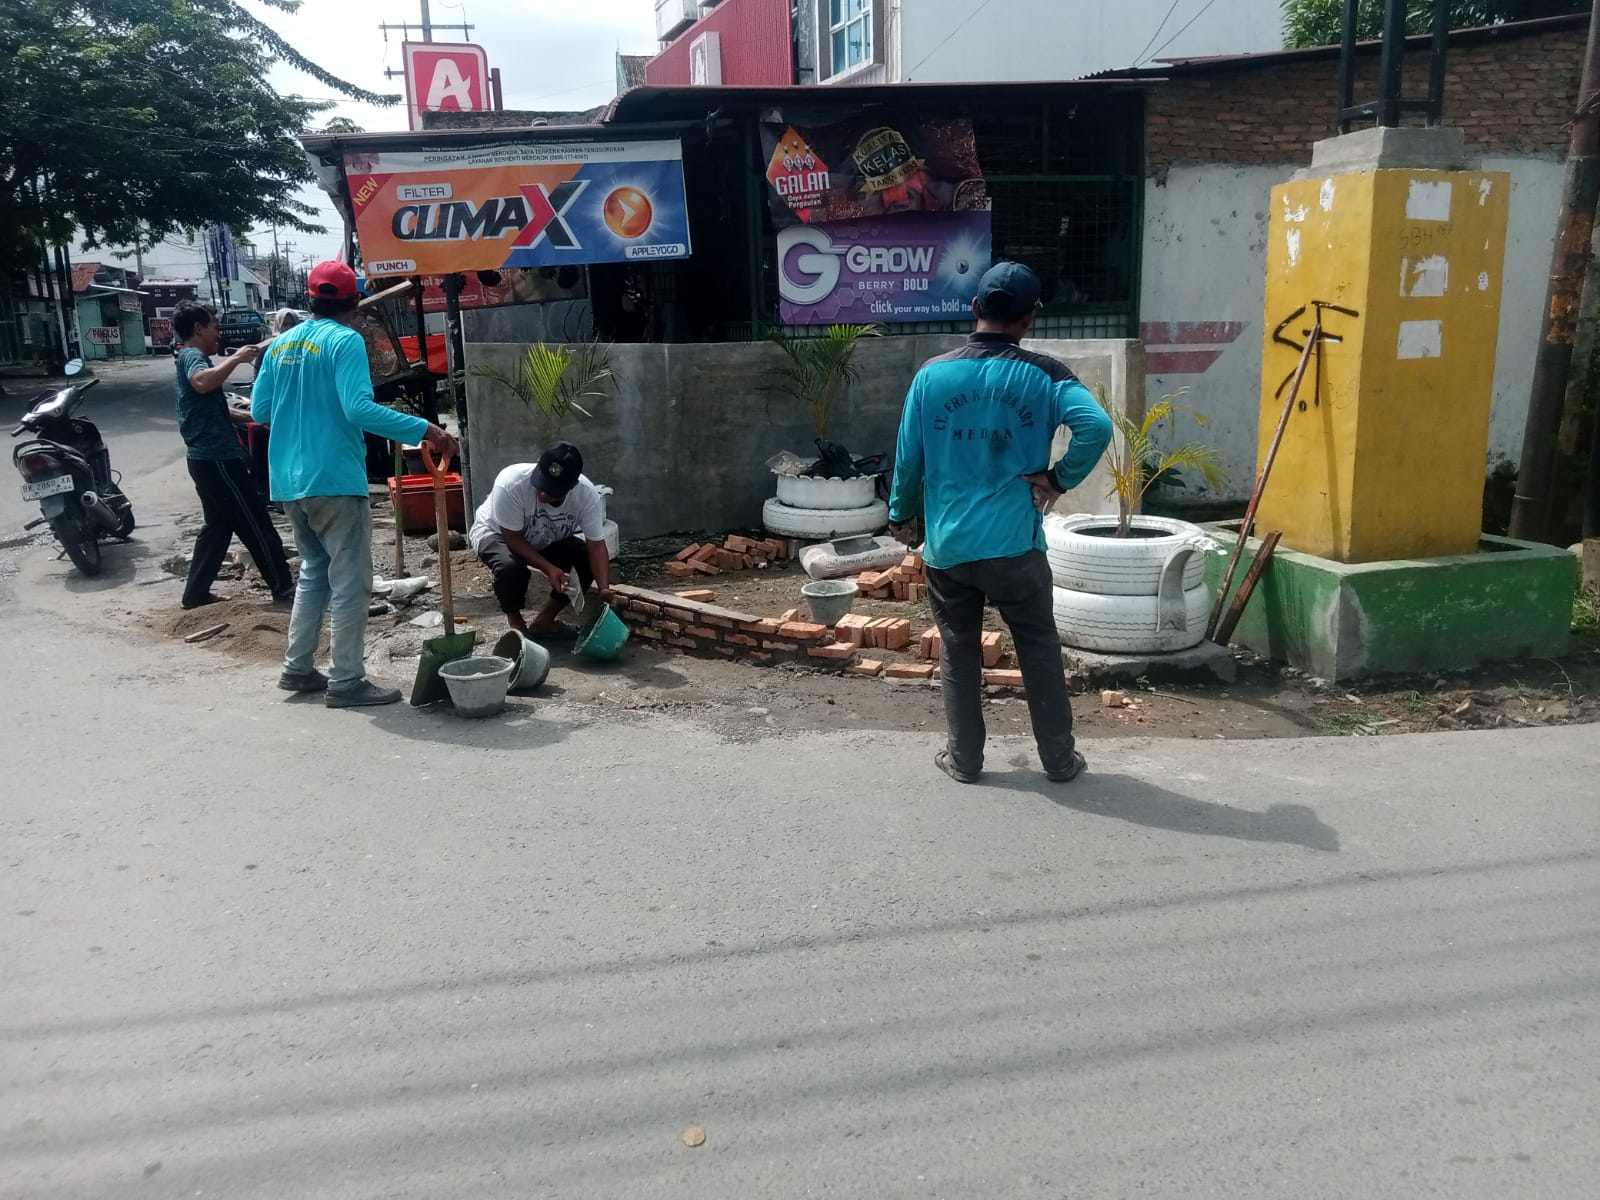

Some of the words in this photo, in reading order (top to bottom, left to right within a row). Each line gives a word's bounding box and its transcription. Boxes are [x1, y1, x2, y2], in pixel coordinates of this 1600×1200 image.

[855, 133, 902, 163] KUALITAS
[863, 145, 907, 173] KELAS
[353, 177, 378, 206] NEW
[404, 186, 446, 200] FILTER
[775, 171, 830, 196] GALAN
[392, 180, 591, 250] CLIMAX
[631, 245, 679, 257] APPLEYOGO
[846, 245, 935, 273] GROW
[376, 261, 408, 272] PUNCH
[858, 281, 896, 290] BERRY
[903, 278, 929, 291] BOLD
[870, 301, 893, 314] click
[893, 305, 912, 315] your
[913, 305, 930, 315] way
[931, 305, 941, 313] to
[941, 299, 960, 313] bold
[961, 303, 973, 312] fla
